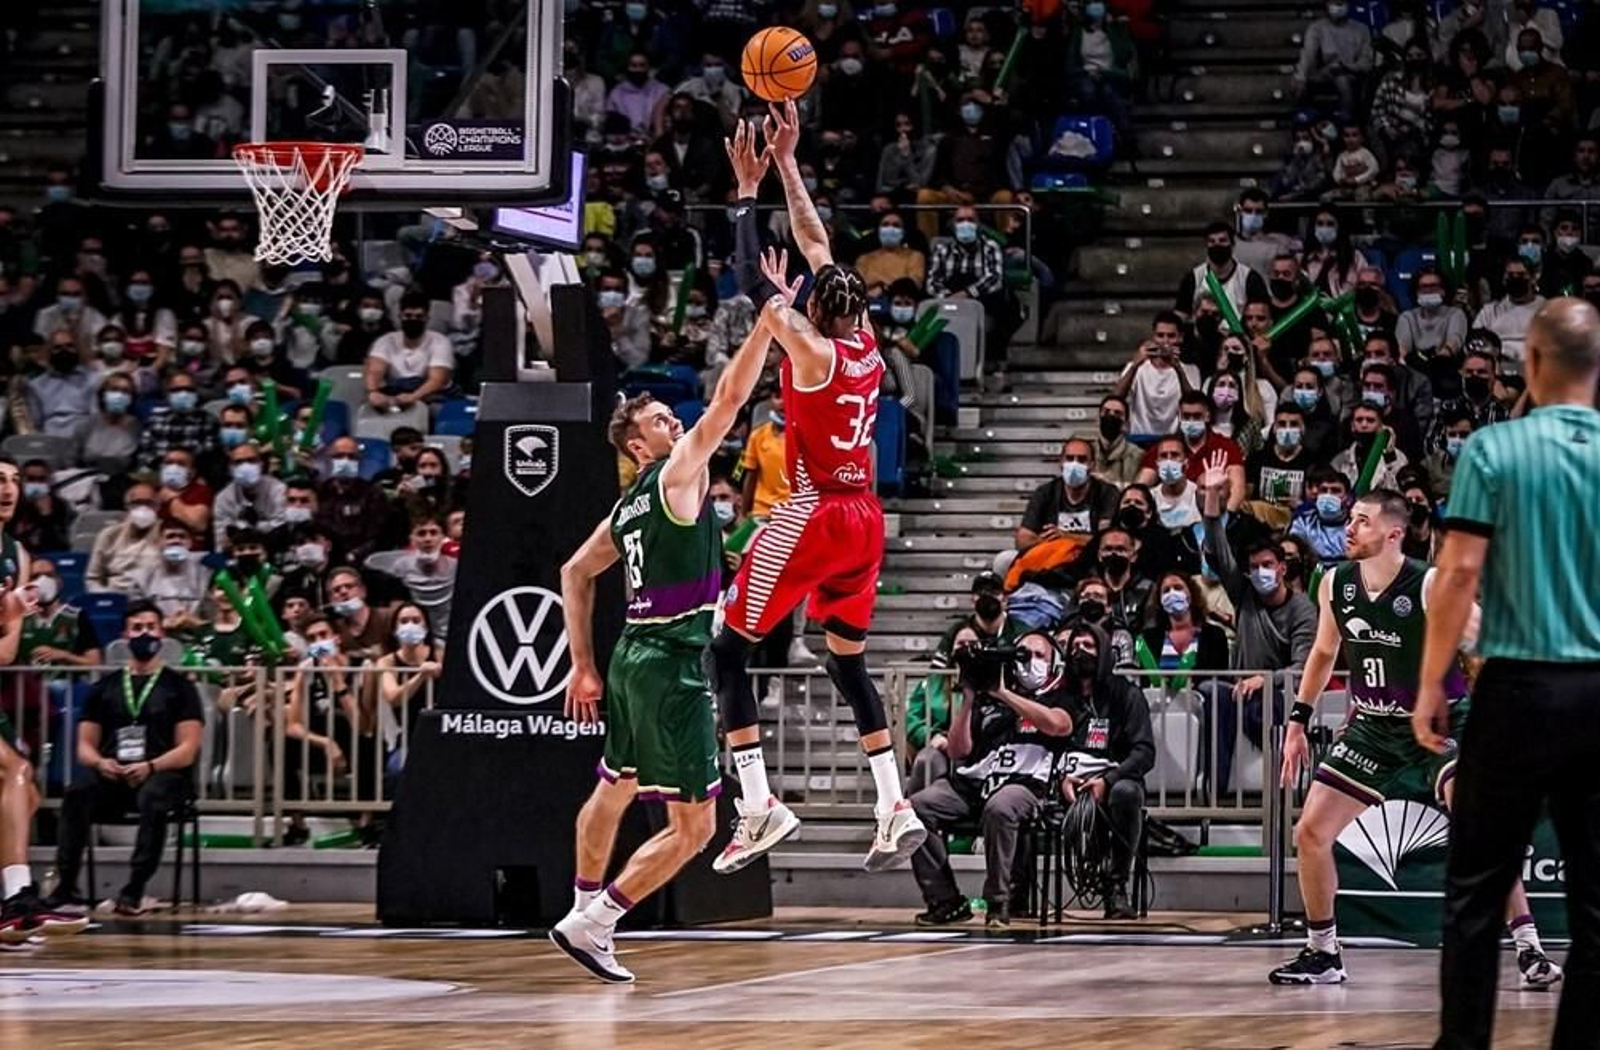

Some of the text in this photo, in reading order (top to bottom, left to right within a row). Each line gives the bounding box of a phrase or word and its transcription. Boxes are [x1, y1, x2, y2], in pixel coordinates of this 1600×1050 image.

[458, 127, 515, 135] BASKETBALL
[458, 135, 521, 145] CHAMPIONS
[458, 144, 493, 153] LEAGUE
[831, 387, 879, 451] 32
[1363, 657, 1385, 688] 31
[441, 713, 606, 741] Málaga Wagen
